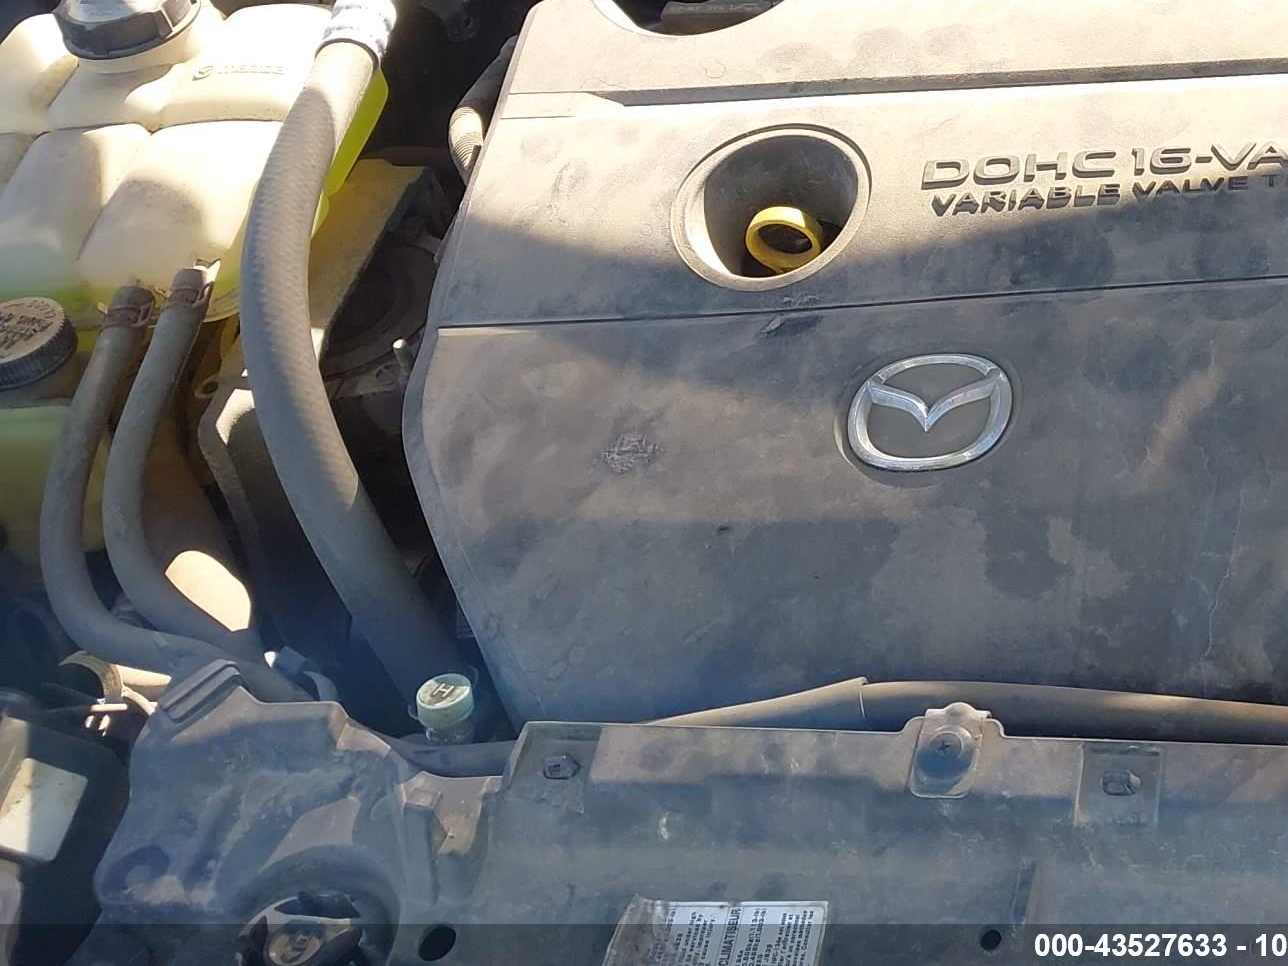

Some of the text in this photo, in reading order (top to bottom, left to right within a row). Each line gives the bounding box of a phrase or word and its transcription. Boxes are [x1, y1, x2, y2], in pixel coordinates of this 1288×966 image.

[922, 150, 1117, 190] DOHC
[930, 184, 1122, 217] VARIABLE
[1131, 176, 1249, 203] VALVE
[432, 682, 455, 698] H
[718, 908, 741, 966] CLIMATISEUR
